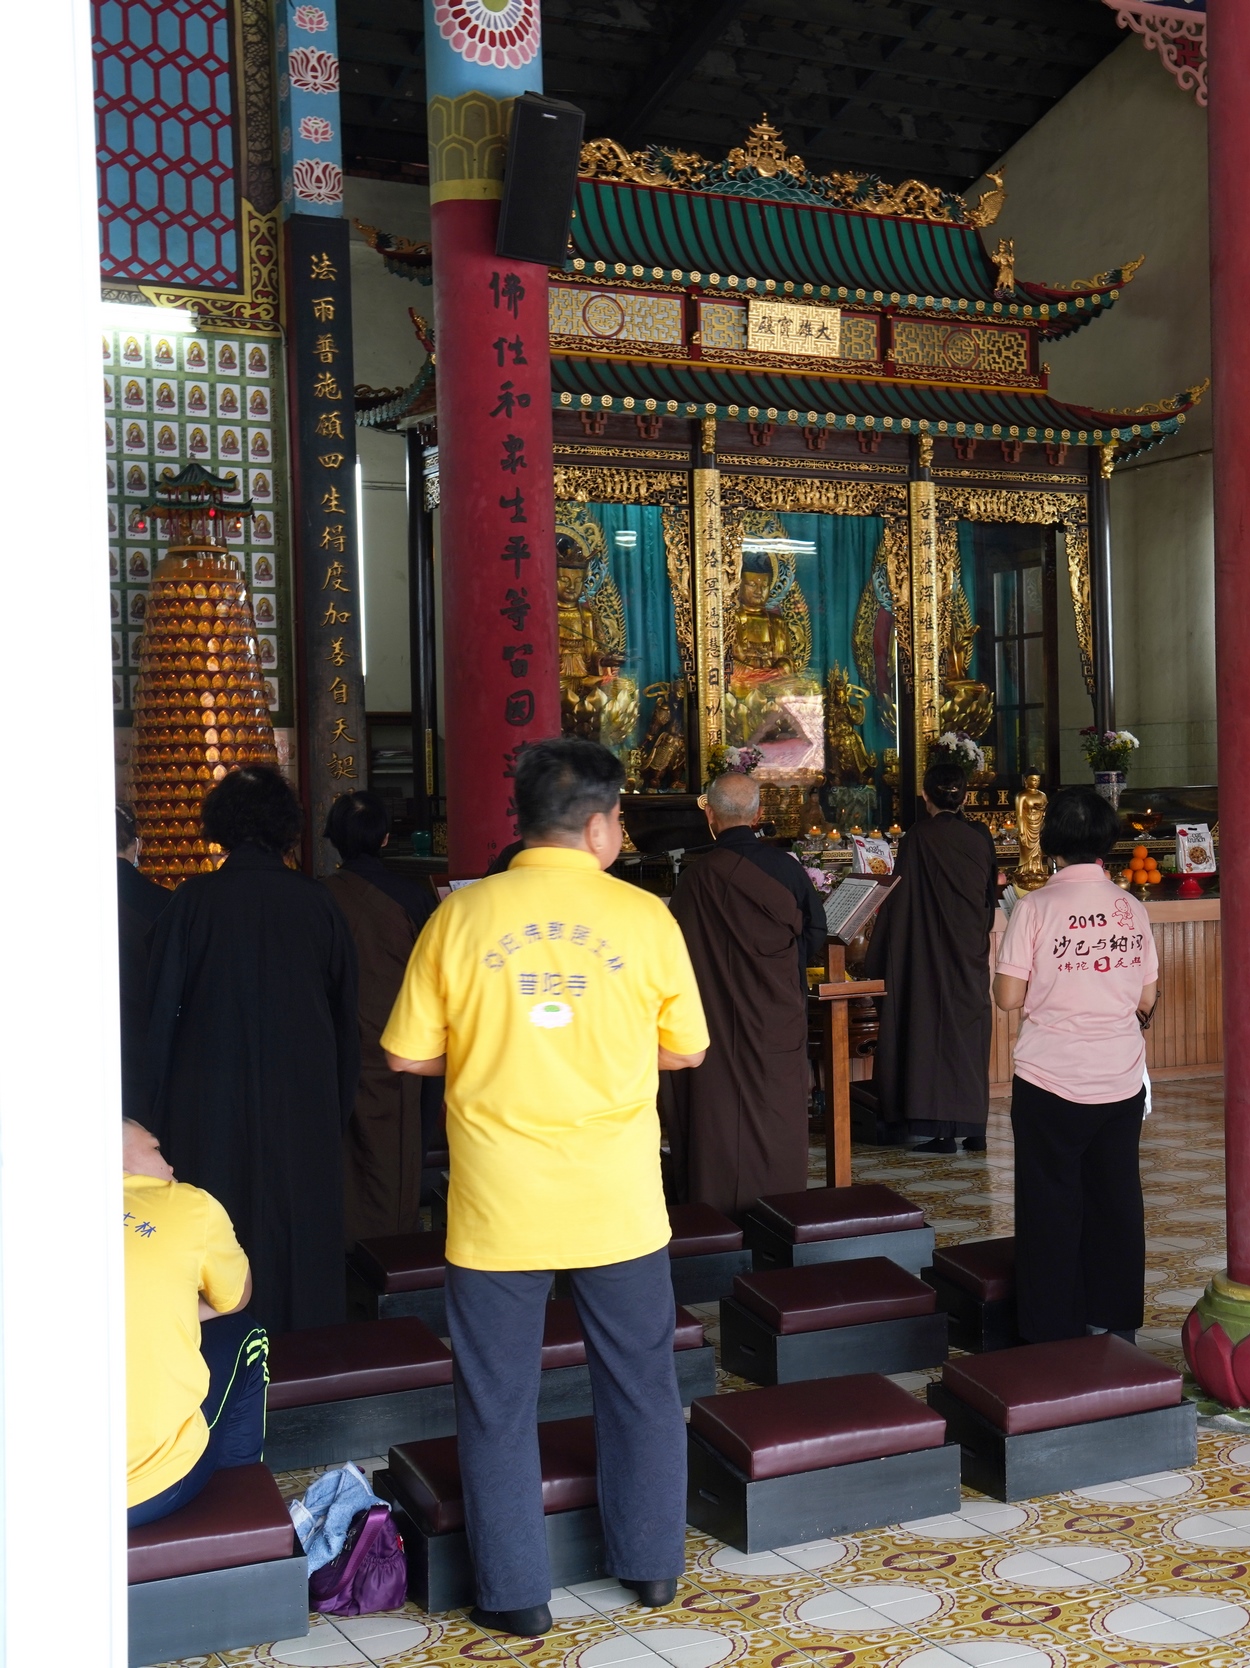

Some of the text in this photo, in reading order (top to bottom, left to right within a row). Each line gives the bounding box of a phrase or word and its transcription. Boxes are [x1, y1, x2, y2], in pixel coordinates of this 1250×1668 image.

[1068, 913, 1107, 930] 2013
[518, 972, 588, 998] 普陀寺
